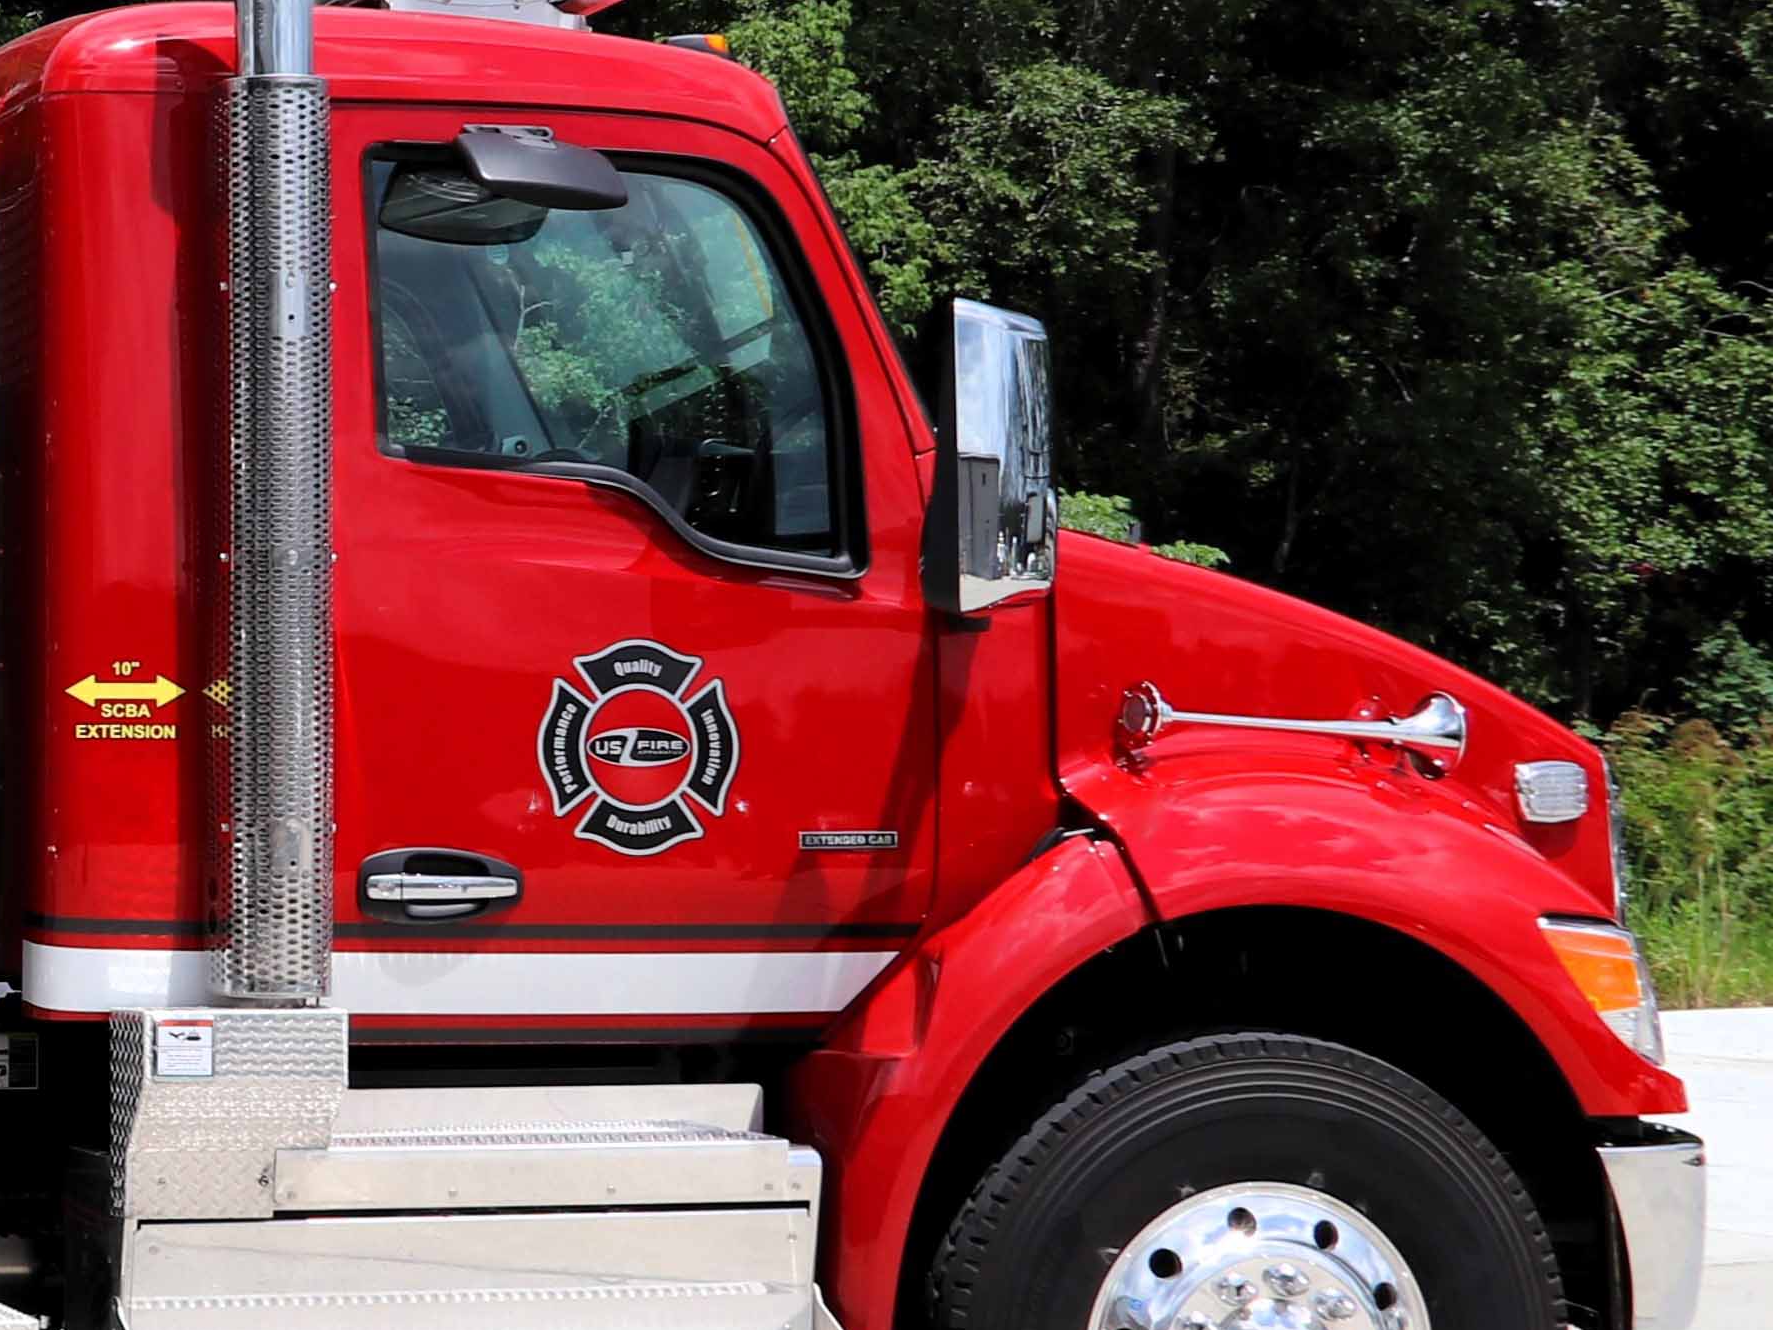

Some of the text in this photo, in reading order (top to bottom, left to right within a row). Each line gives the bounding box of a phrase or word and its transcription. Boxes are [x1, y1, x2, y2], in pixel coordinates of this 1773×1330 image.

[112, 661, 140, 676] 10"
[613, 659, 663, 677] Quality
[101, 703, 151, 718] SCBA
[75, 724, 176, 739] EXTENSION
[553, 703, 578, 794] Performance
[594, 740, 684, 755] US FIRE
[700, 709, 722, 786] Innovation
[606, 814, 673, 835] Durability
[804, 834, 893, 845] EXTENDED CAB
